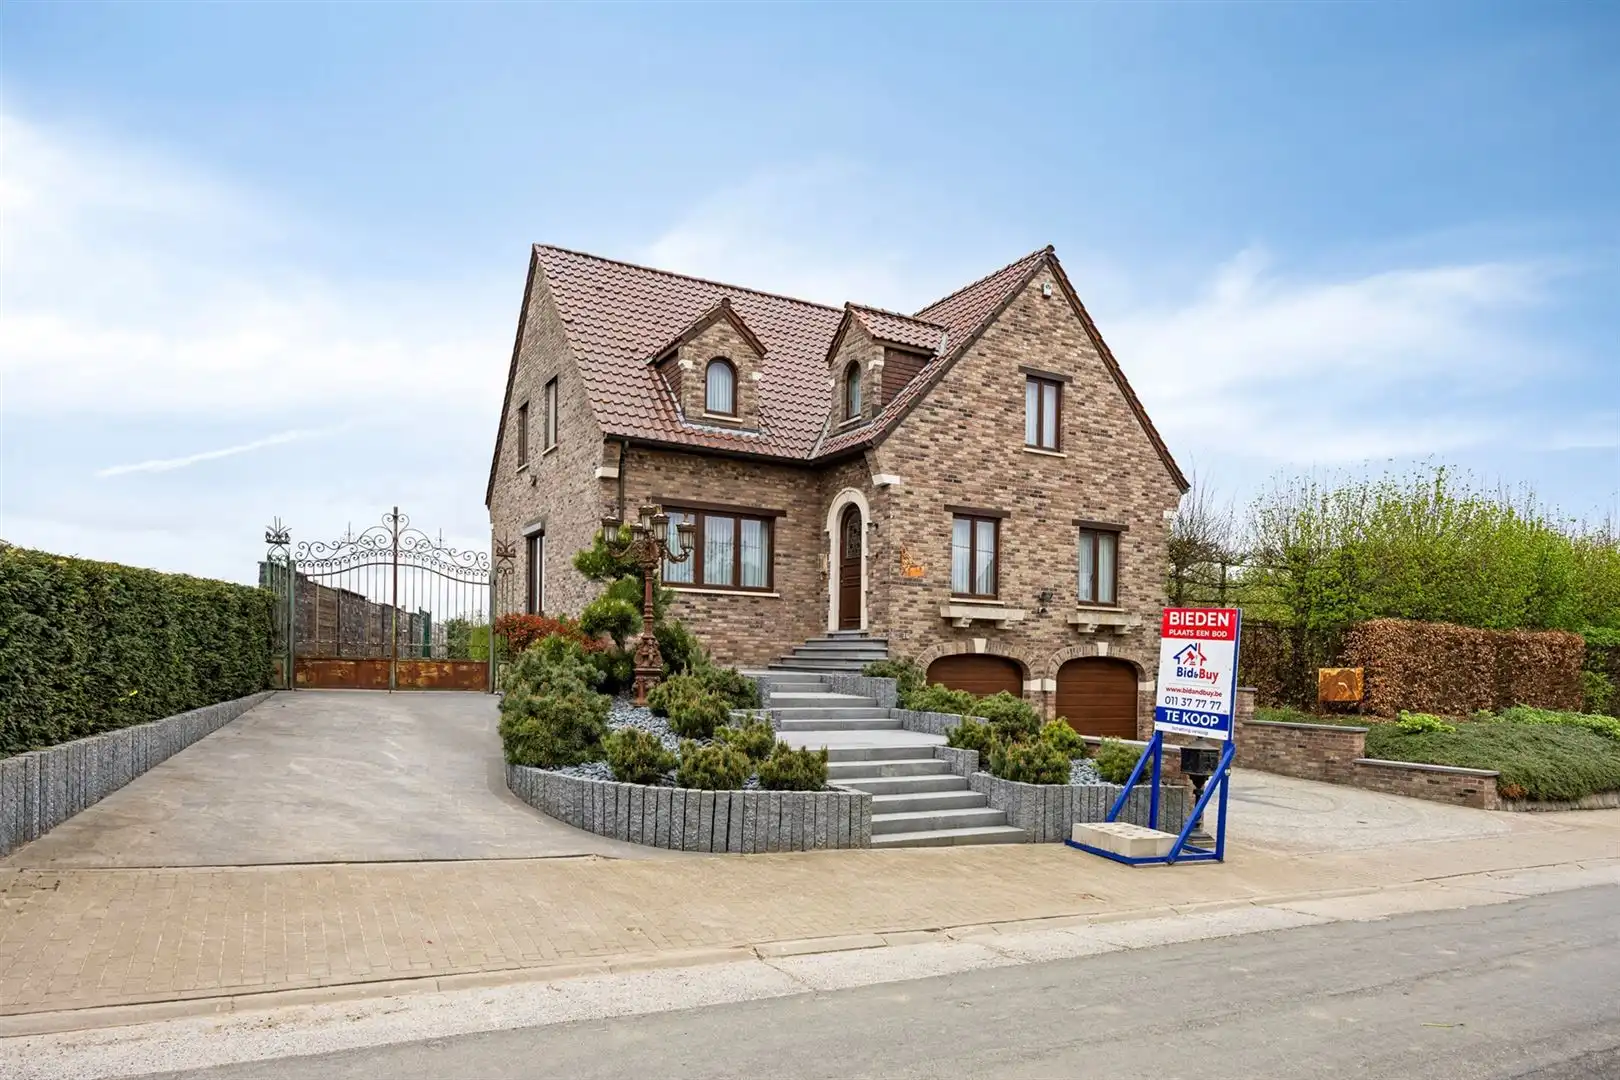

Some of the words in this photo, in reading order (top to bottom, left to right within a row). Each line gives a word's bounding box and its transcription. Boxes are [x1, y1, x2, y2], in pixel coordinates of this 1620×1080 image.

[1169, 611, 1230, 626] BIEDEN
[1166, 687, 1222, 698] www.bidandbuy.be
[1164, 696, 1178, 706] 011
[1181, 697, 1192, 707] 37
[1195, 699, 1207, 709] 77
[1210, 700, 1222, 711] 77
[1165, 709, 1180, 722] TE
[1182, 712, 1219, 727] KOOP
